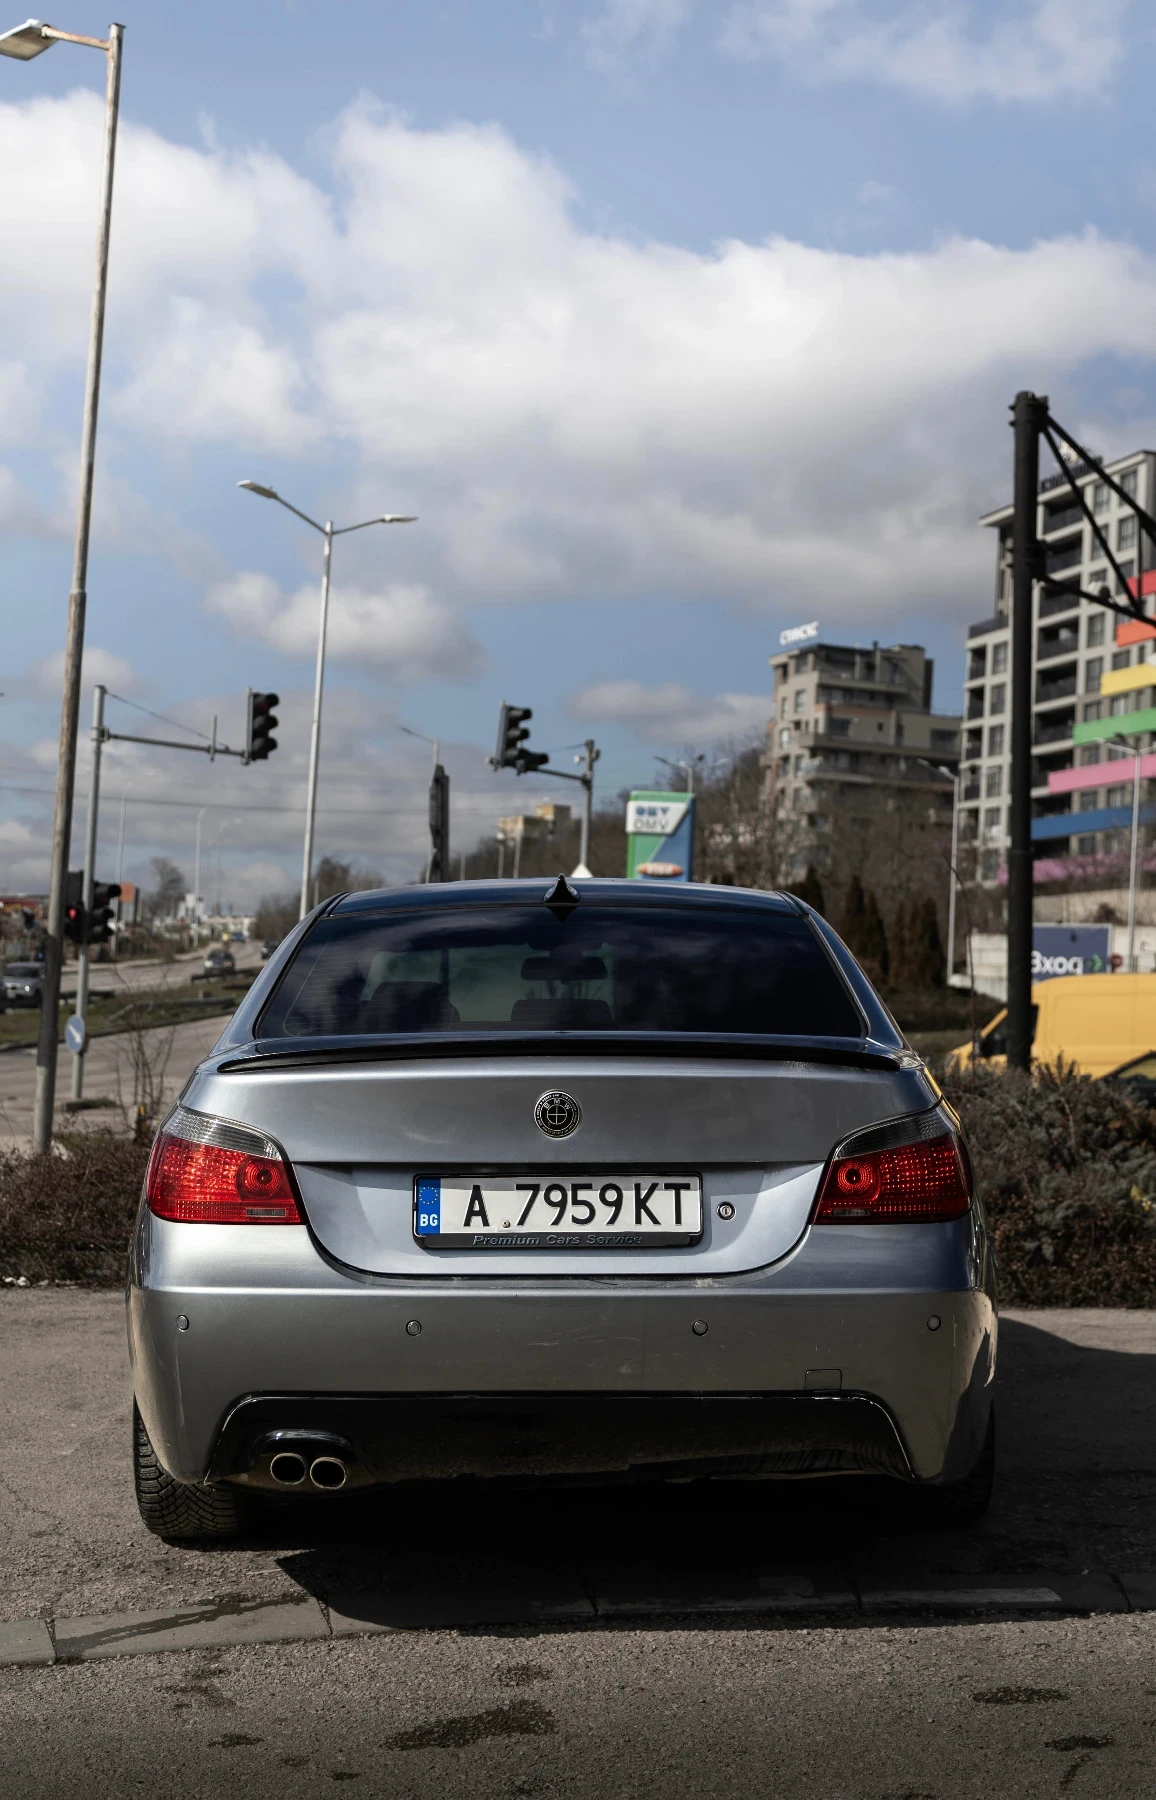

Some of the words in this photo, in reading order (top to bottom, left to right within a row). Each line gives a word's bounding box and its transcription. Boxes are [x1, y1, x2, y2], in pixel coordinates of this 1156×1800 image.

[634, 819, 669, 830] OMV
[543, 1097, 572, 1110] BMW
[420, 1213, 438, 1227] BG
[473, 1235, 540, 1246] Premium
[546, 1234, 580, 1245] Cars
[586, 1234, 643, 1245] Service
